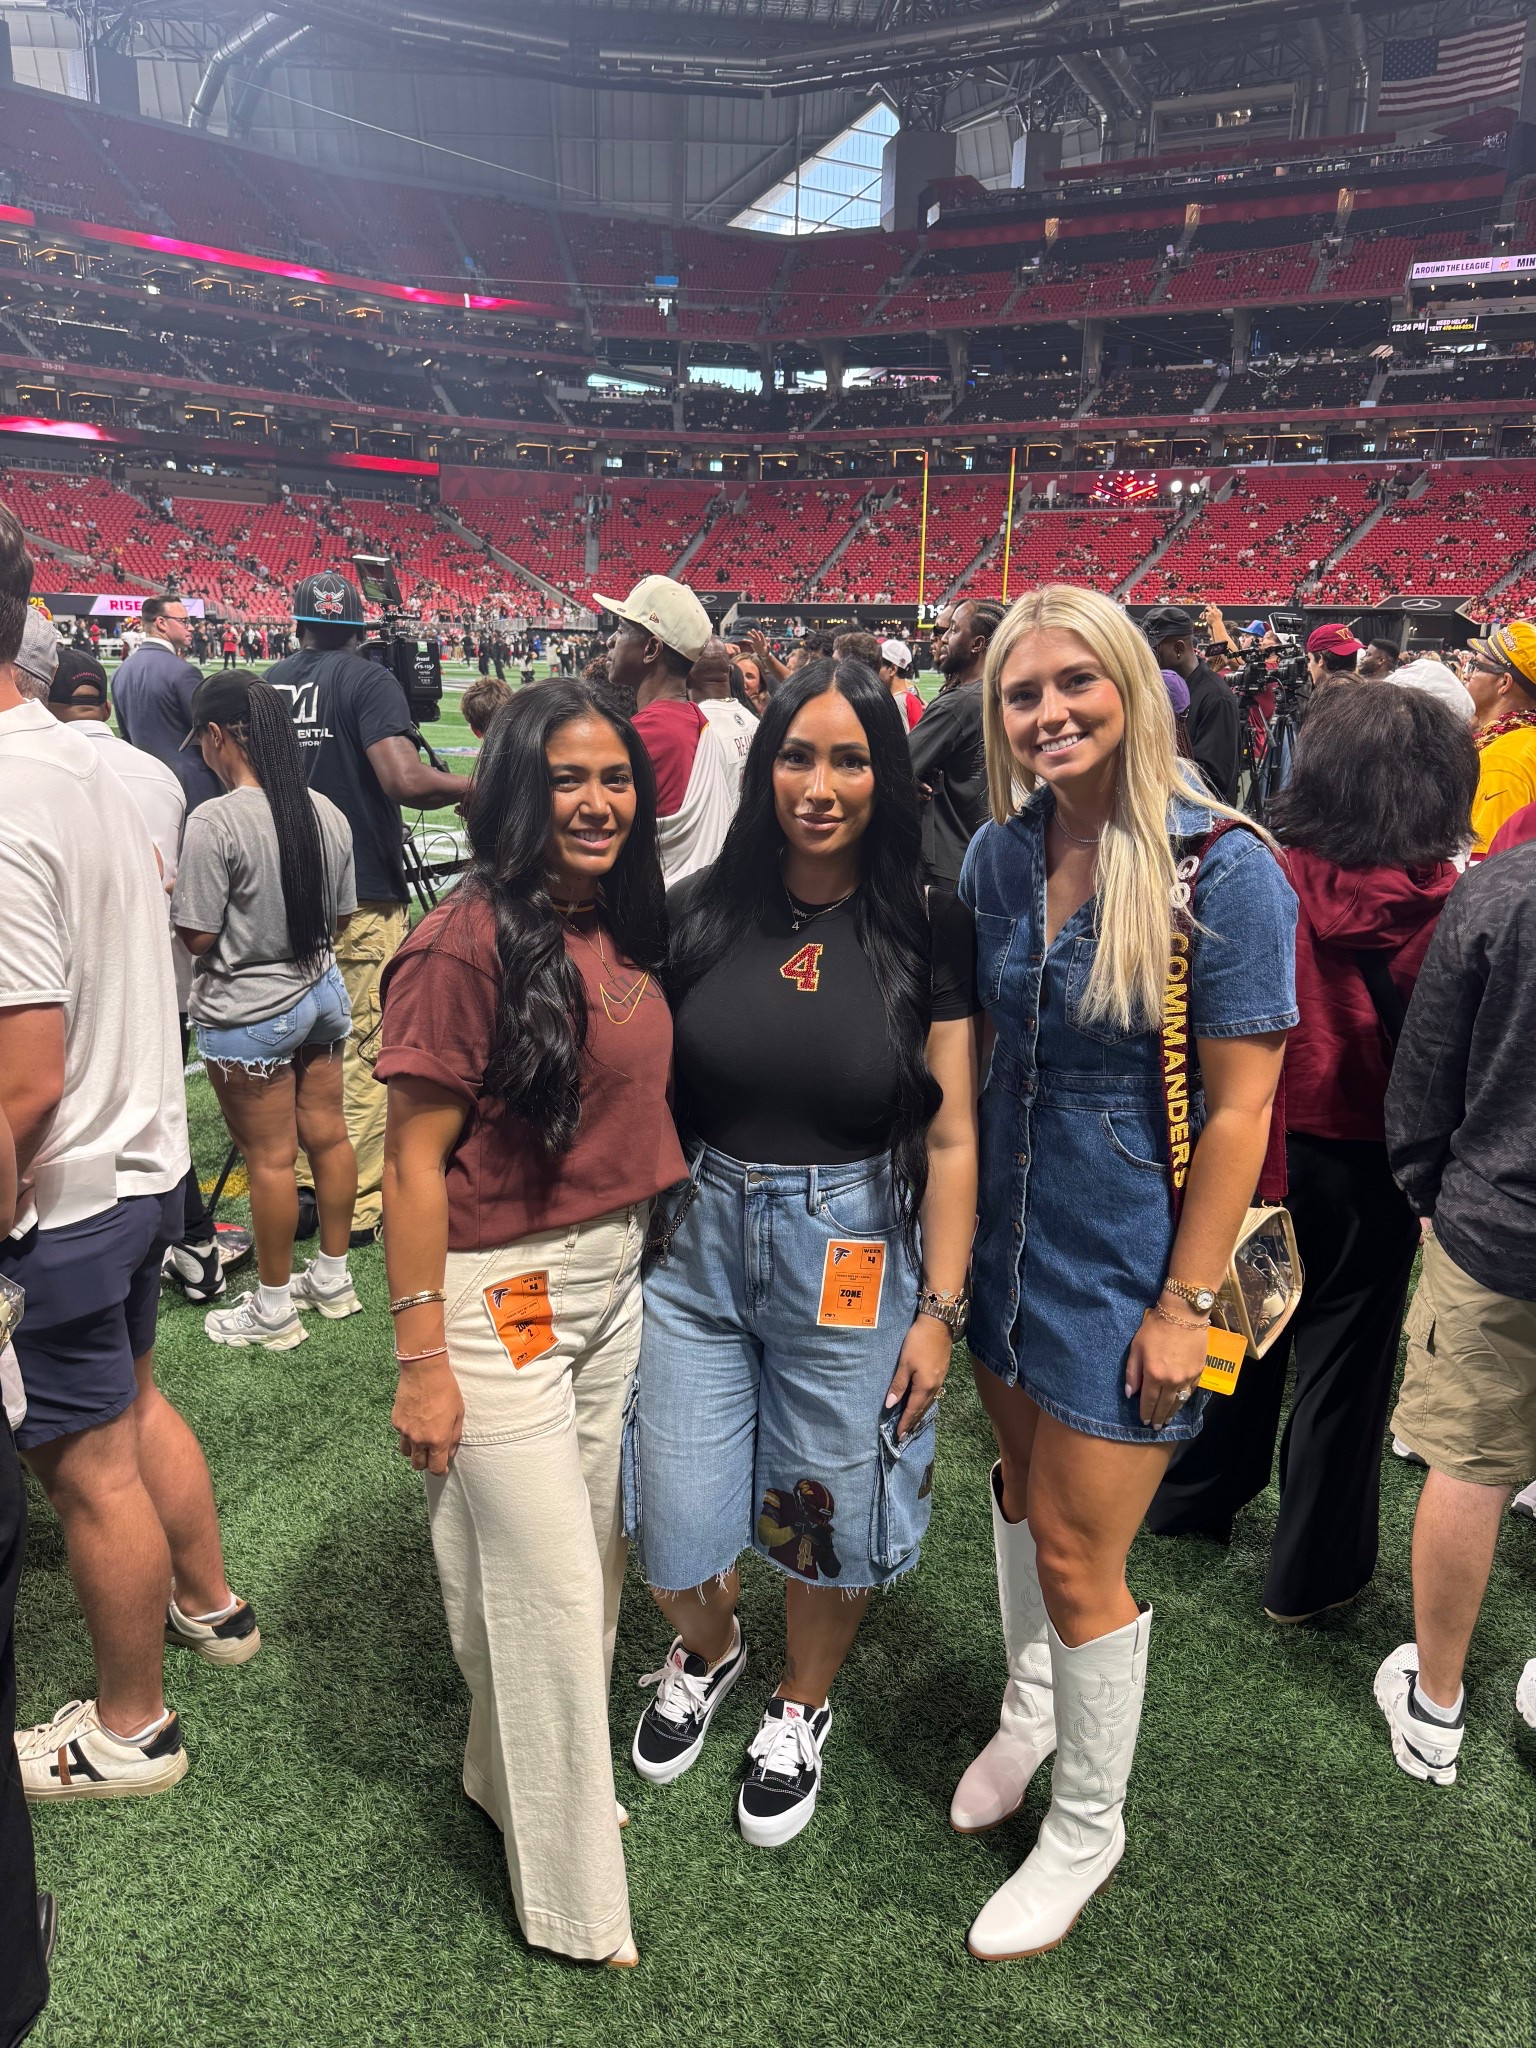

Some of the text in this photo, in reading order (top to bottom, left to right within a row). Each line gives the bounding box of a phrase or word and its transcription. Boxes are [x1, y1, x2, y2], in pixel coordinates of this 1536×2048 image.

[1415, 261, 1490, 274] AROUND THE LEAGUE
[1392, 322, 1426, 332] 12:24 PM
[110, 600, 142, 611] RISE
[780, 943, 824, 991] 4
[1163, 932, 1192, 1188] COMMANDERS
[867, 1256, 876, 1264] 4
[522, 1275, 543, 1283] WEEK
[840, 1289, 862, 1298] ZONE
[846, 1299, 852, 1307] 2
[527, 1328, 534, 1337] 2
[1206, 1354, 1236, 1374] NORTH
